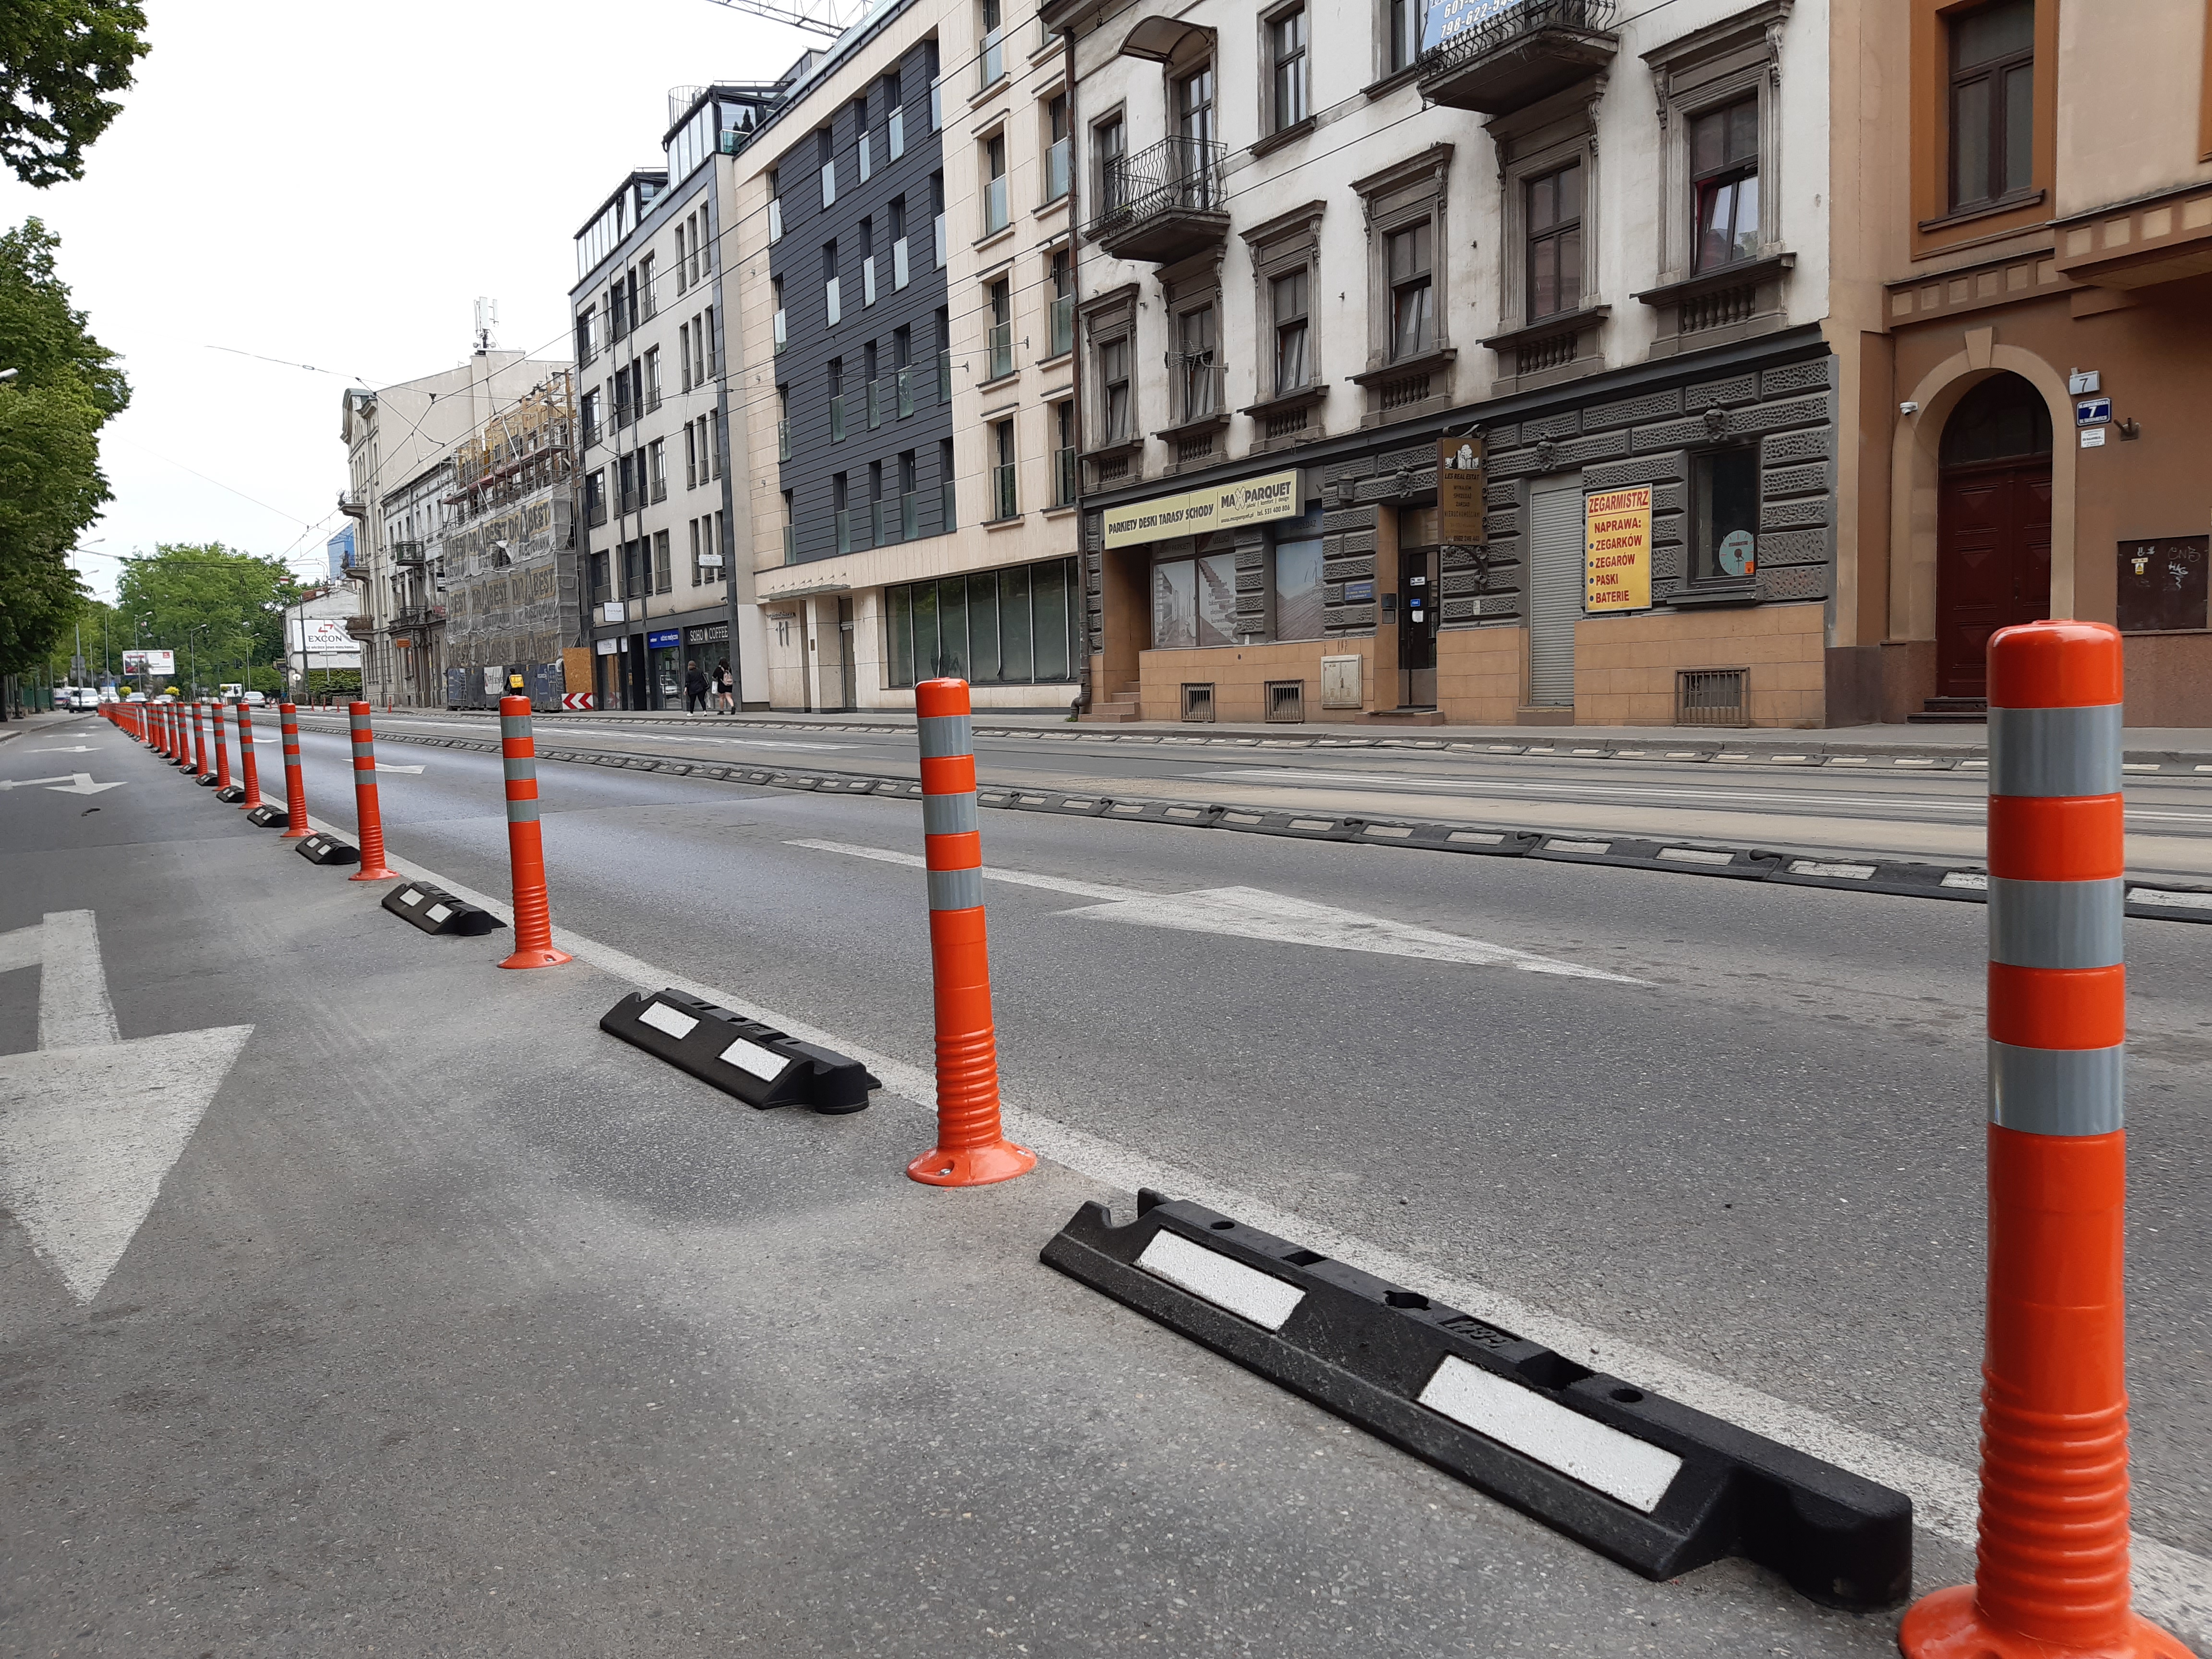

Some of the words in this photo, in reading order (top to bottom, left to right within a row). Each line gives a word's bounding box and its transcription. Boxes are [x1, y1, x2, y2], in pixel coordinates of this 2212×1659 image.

[2080, 378, 2088, 392] 7
[2089, 406, 2097, 418] 7
[1588, 490, 1648, 513] ZEGARMISTRZ
[1108, 519, 1137, 534] PARKIETY
[1139, 515, 1157, 529] DESKI
[1159, 510, 1184, 525] TARASY
[1185, 504, 1214, 520] SCHODY
[1594, 517, 1641, 534] NAPRAWA:
[1595, 533, 1642, 551] ZEGARKÓW
[1595, 552, 1635, 568] ZEGARÓW
[1596, 573, 1618, 586] PASKI
[1596, 590, 1629, 603] BATERIE
[690, 629, 703, 641] SOHO
[709, 625, 728, 639] COFFEE
[775, 621, 789, 647] 11
